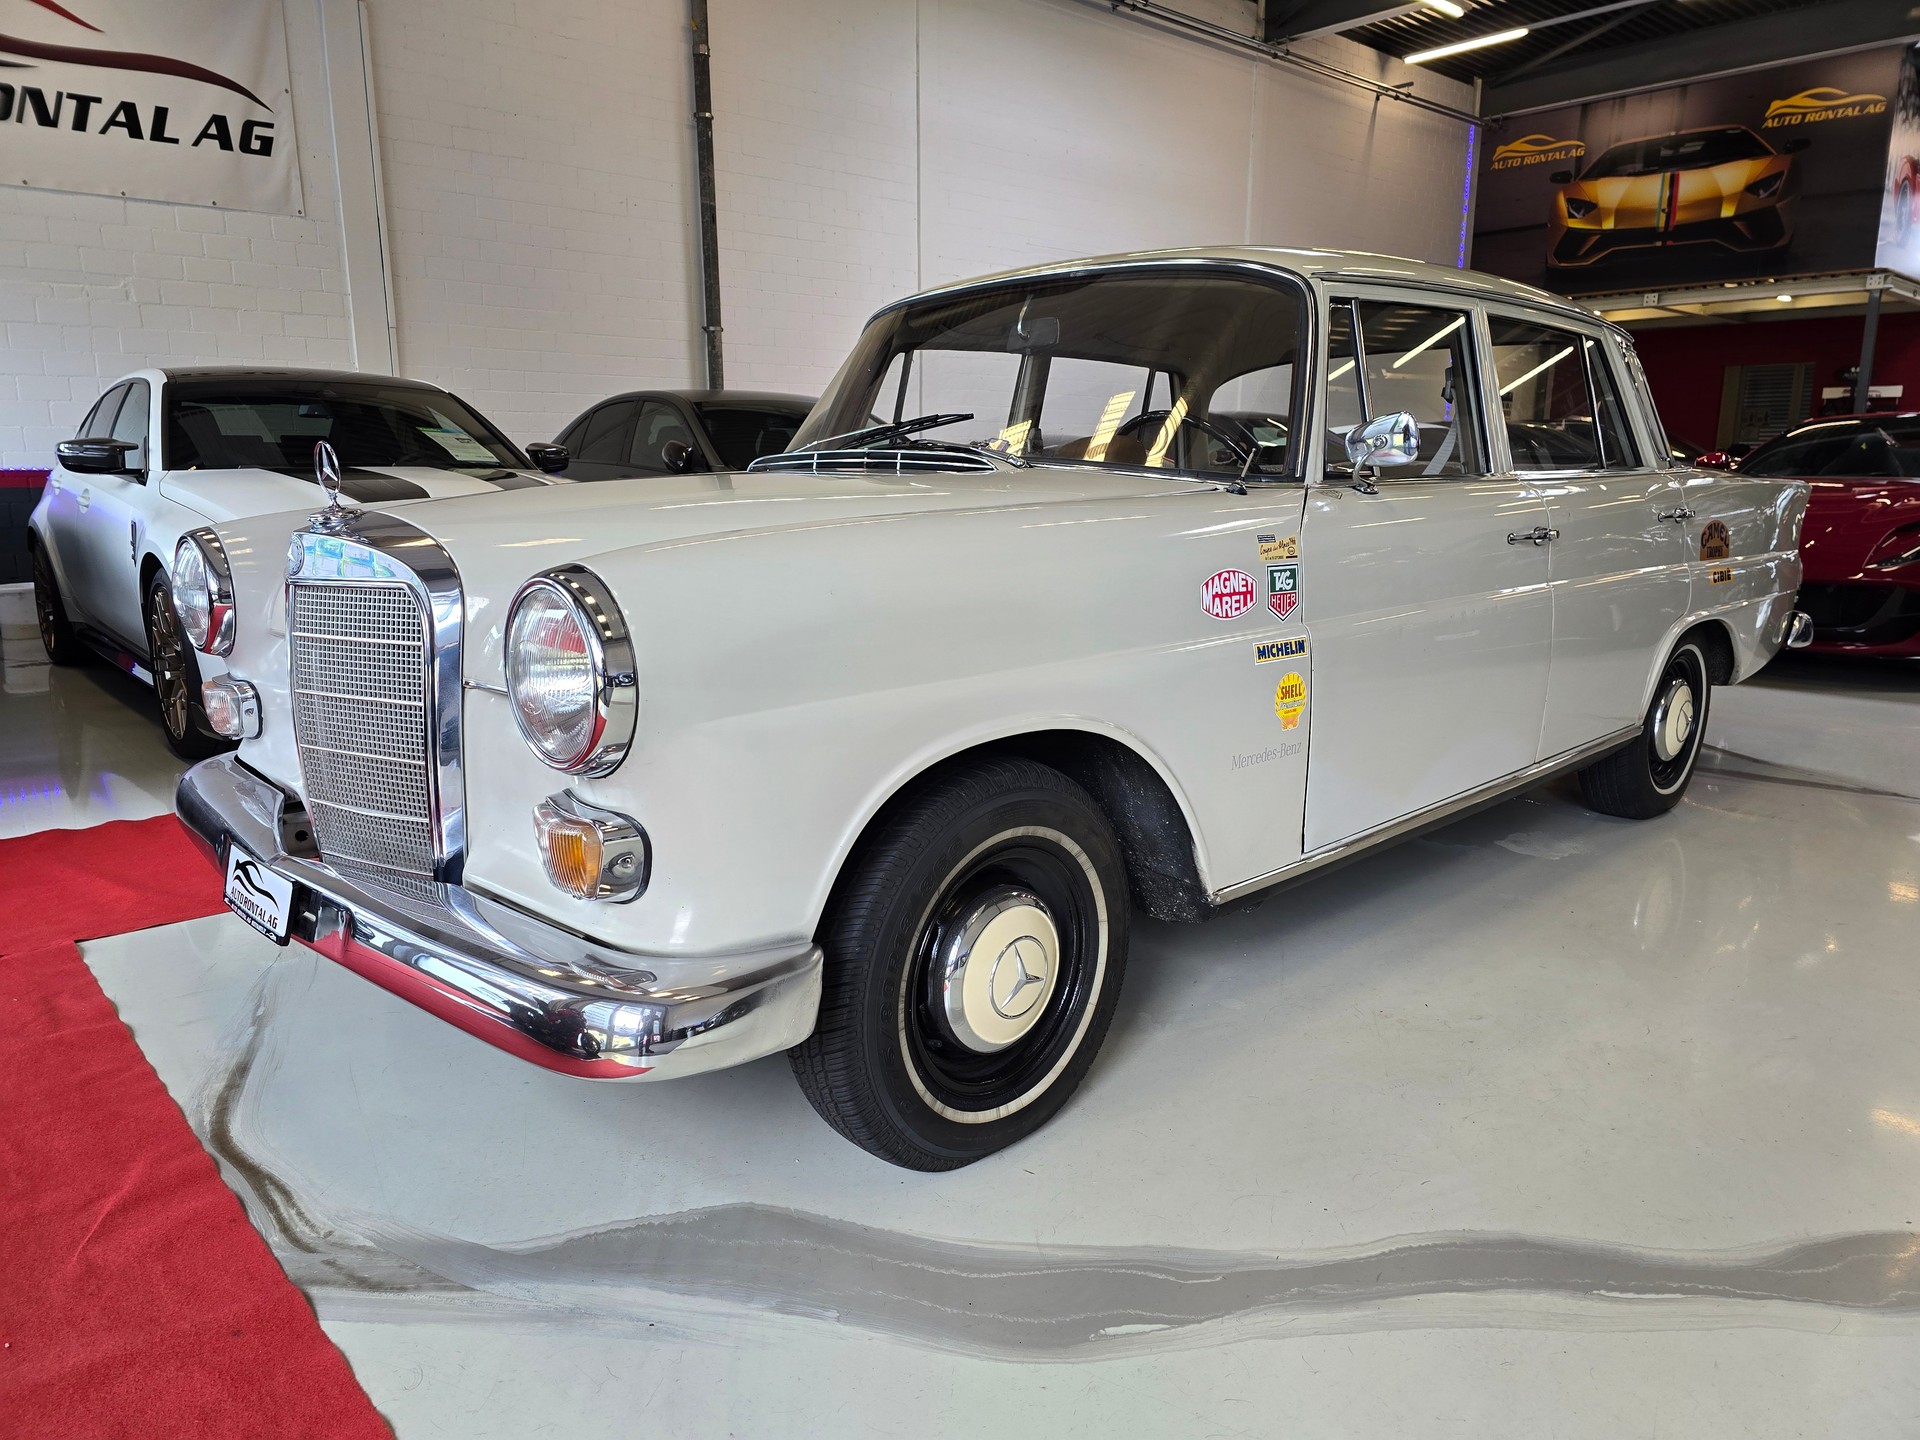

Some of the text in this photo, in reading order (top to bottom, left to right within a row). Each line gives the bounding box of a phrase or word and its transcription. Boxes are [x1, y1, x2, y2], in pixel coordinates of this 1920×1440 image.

[1762, 101, 1887, 128] AUTO RONTAL AG
[191, 114, 275, 157] AG
[1491, 147, 1585, 170] AUTO RONTAL AG
[1701, 522, 1729, 549] CAMEL
[1273, 570, 1294, 591] TAG
[1271, 593, 1297, 615] HEUER
[1256, 639, 1306, 661] MICHELIN
[1280, 683, 1302, 700] SHELL
[1231, 742, 1303, 771] Mercedes-Benz
[265, 914, 279, 930] AG
